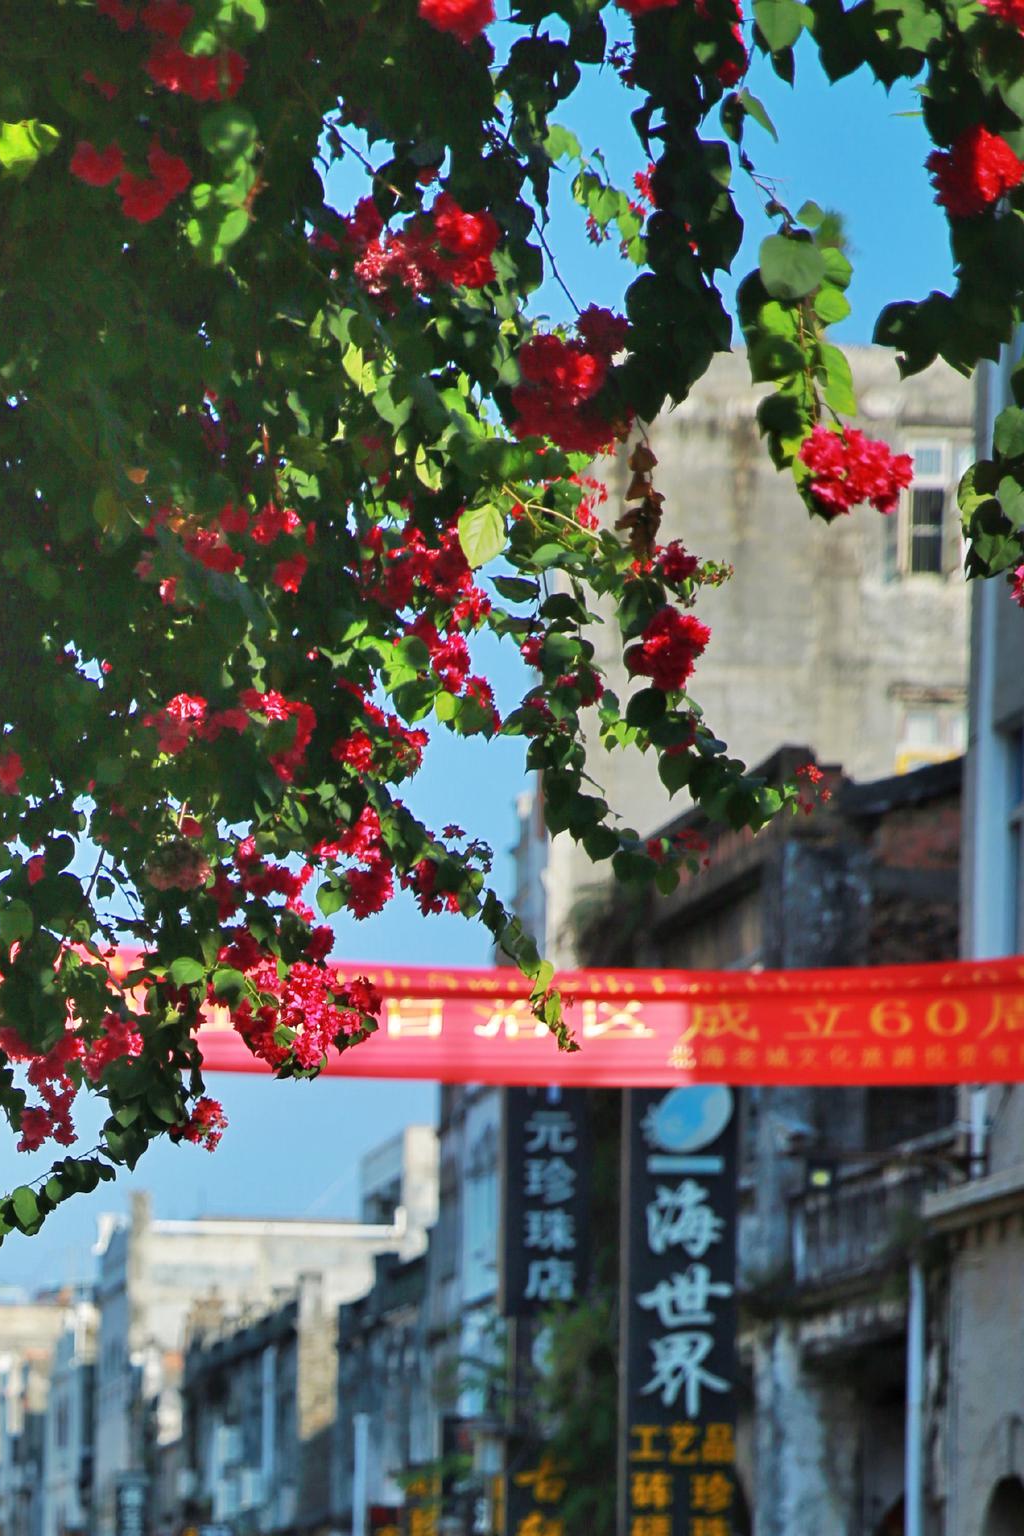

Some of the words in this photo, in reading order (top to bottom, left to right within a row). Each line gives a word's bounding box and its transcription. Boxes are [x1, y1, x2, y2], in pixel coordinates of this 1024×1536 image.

[667, 1043, 1024, 1070] 北海老城文化旅游投资有
[524, 1086, 577, 1300] 元珍珠店
[638, 1179, 733, 1419] 海世界
[629, 1423, 735, 1463] 工艺品
